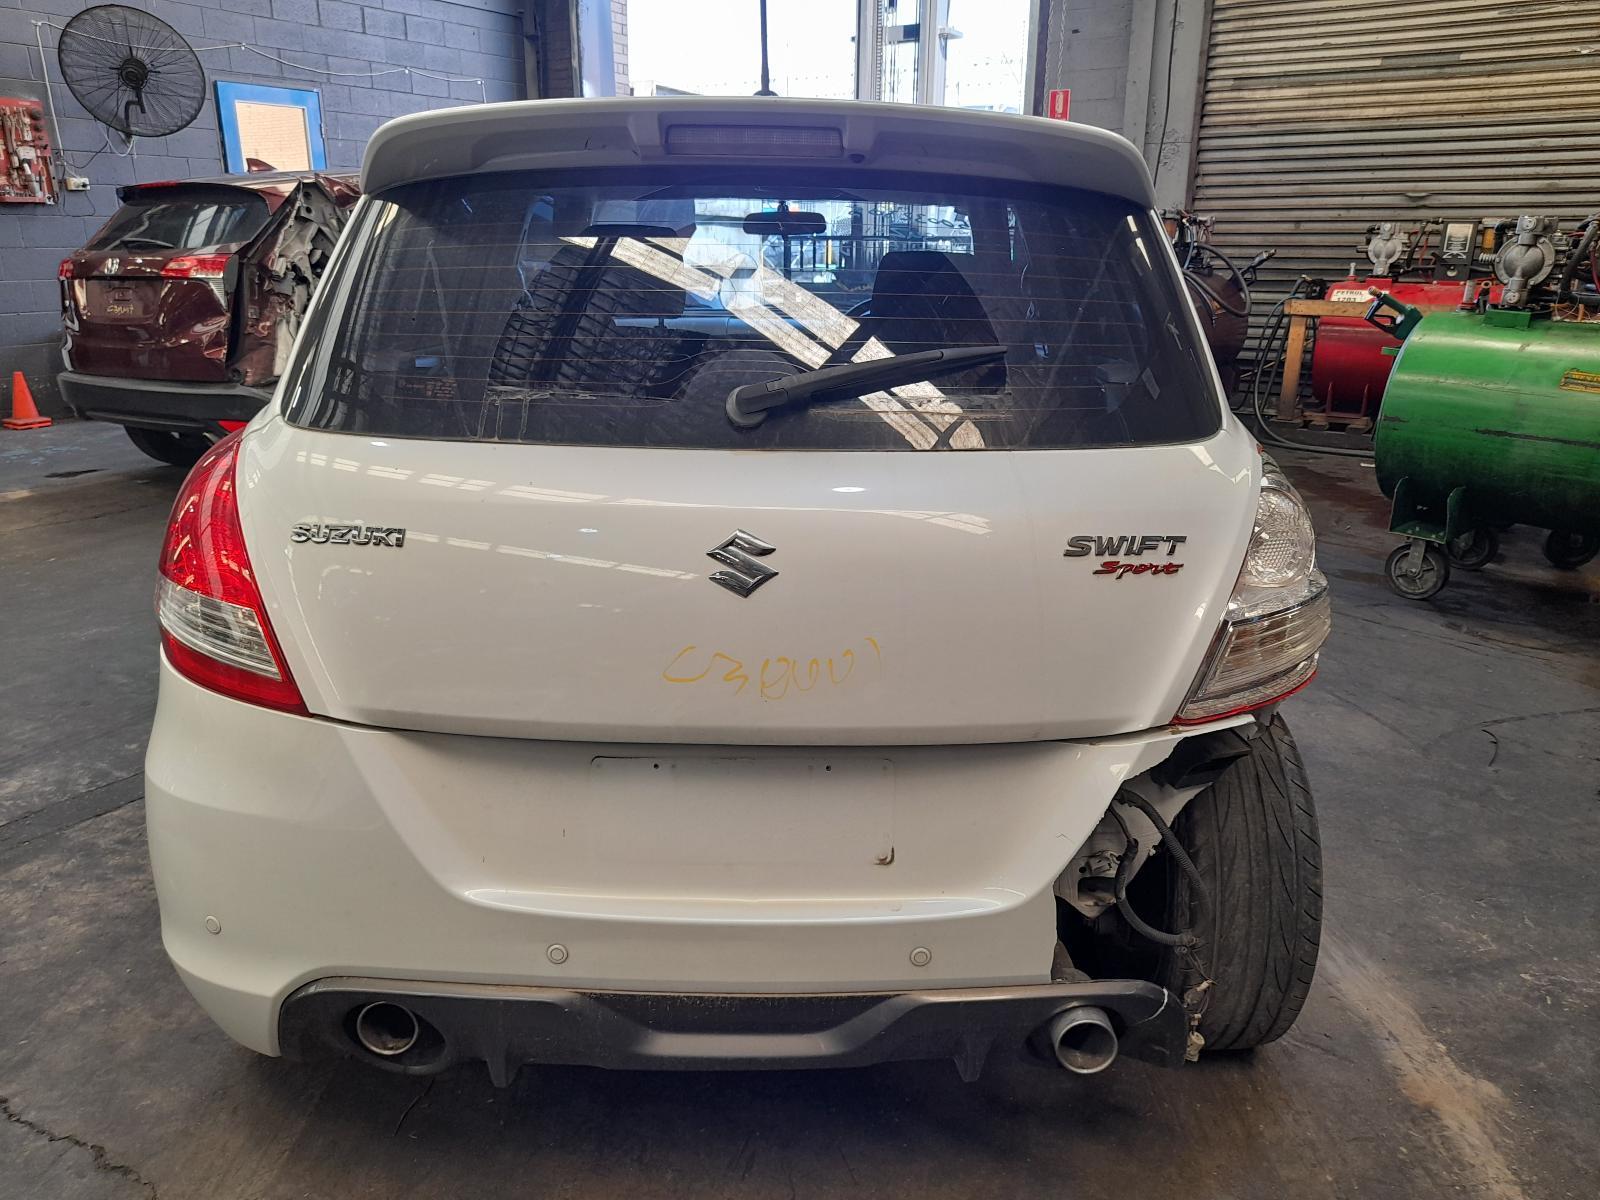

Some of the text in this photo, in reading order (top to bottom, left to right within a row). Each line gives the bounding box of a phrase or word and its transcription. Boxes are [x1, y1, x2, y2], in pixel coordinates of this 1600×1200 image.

[291, 524, 406, 547] SUZUKI
[1063, 535, 1187, 557] SWIFT
[1092, 561, 1184, 580] Sport
